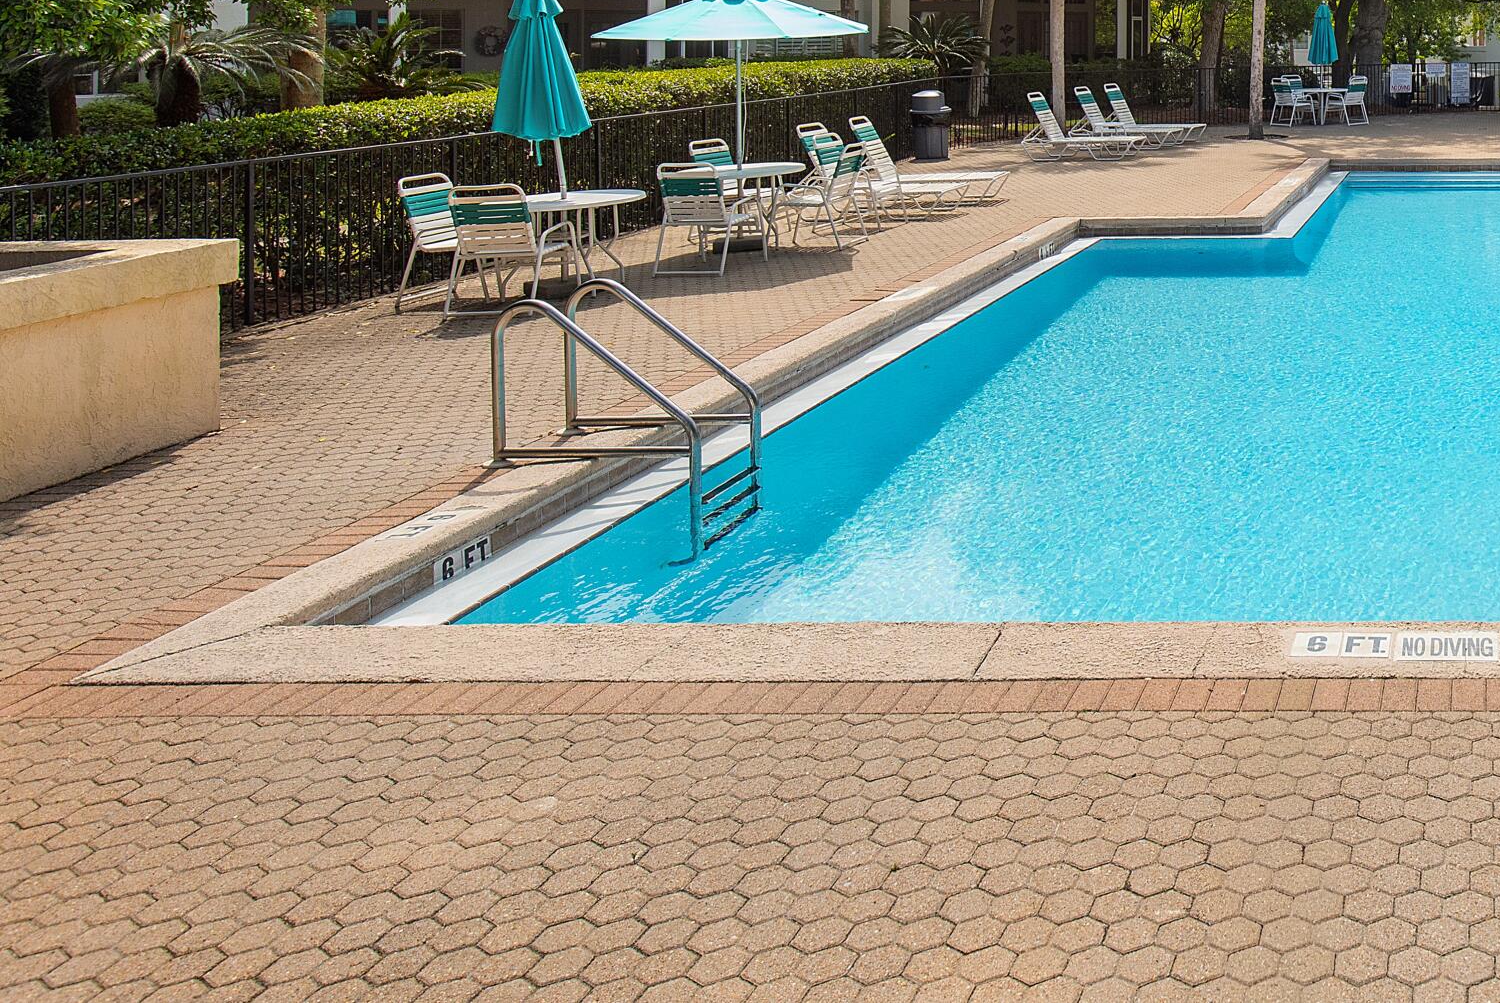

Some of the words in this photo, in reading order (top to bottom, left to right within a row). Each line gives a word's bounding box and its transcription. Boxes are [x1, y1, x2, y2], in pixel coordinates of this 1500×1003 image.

[442, 556, 454, 581] 6
[1307, 635, 1328, 652] 6
[1402, 637, 1425, 657] NO
[1430, 637, 1494, 657] DIVING
